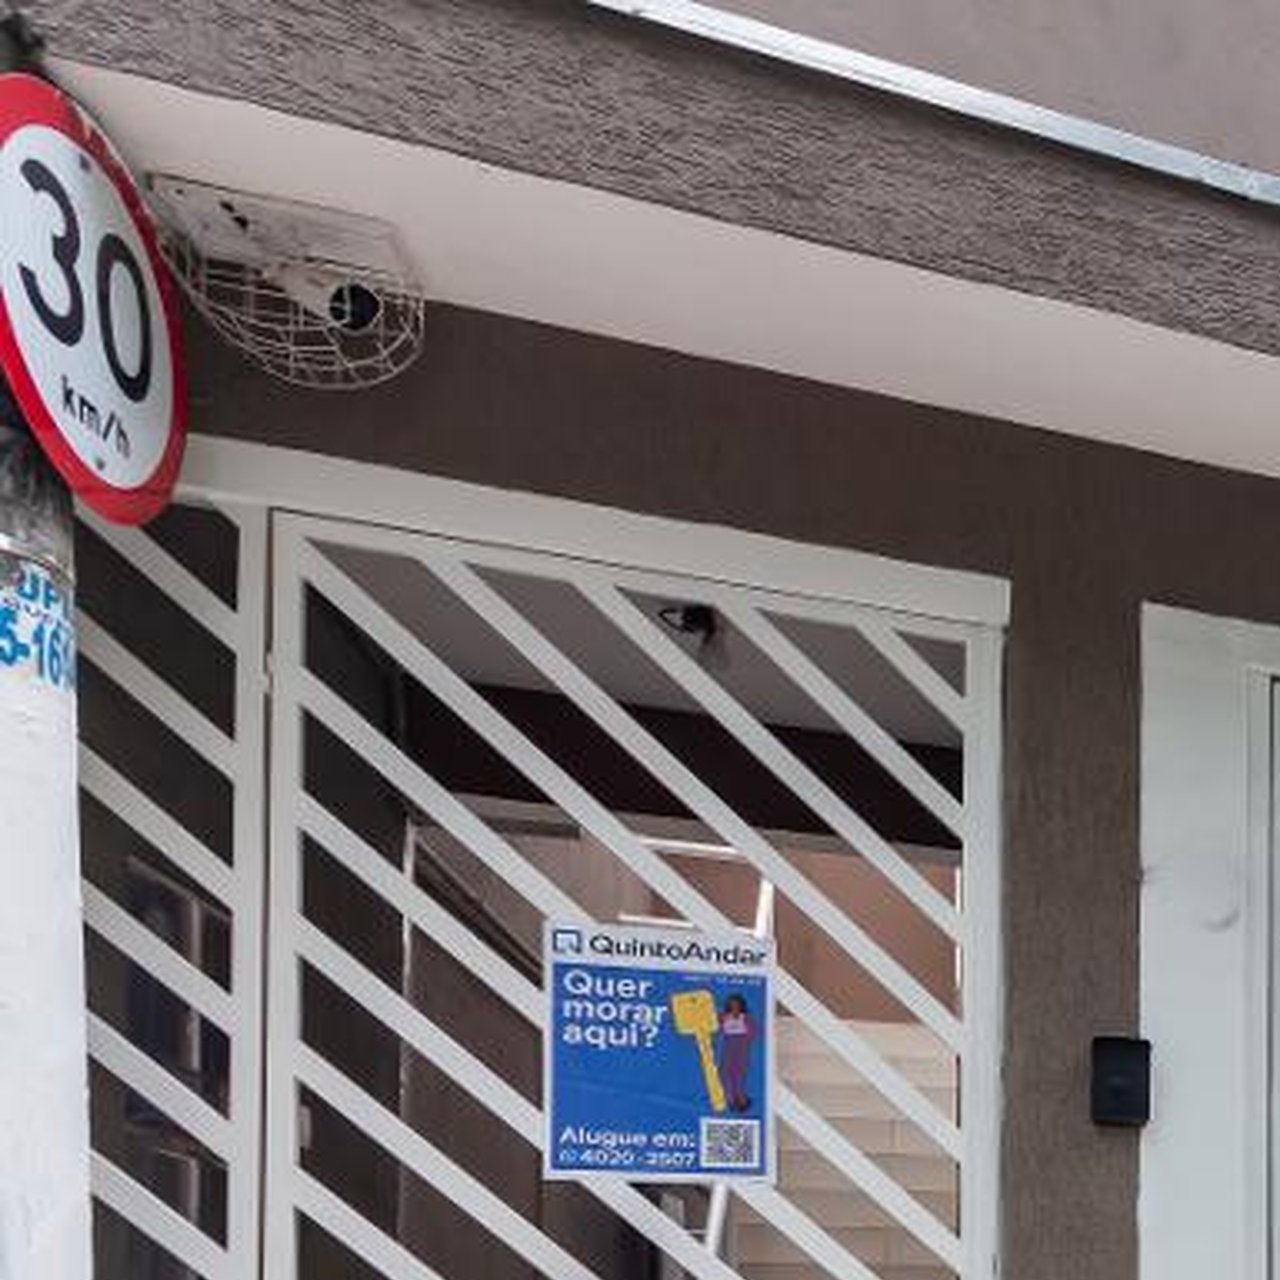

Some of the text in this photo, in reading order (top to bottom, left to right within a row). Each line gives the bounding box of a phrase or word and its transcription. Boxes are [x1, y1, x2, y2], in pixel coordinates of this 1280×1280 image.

[18, 158, 153, 404] 30
[60, 373, 132, 460] km/h
[589, 934, 768, 966] QuintoAndar
[563, 969, 653, 998] Quer
[562, 999, 668, 1023] morar
[562, 1022, 659, 1050] aqui?
[558, 1125, 696, 1149] Alugue em:
